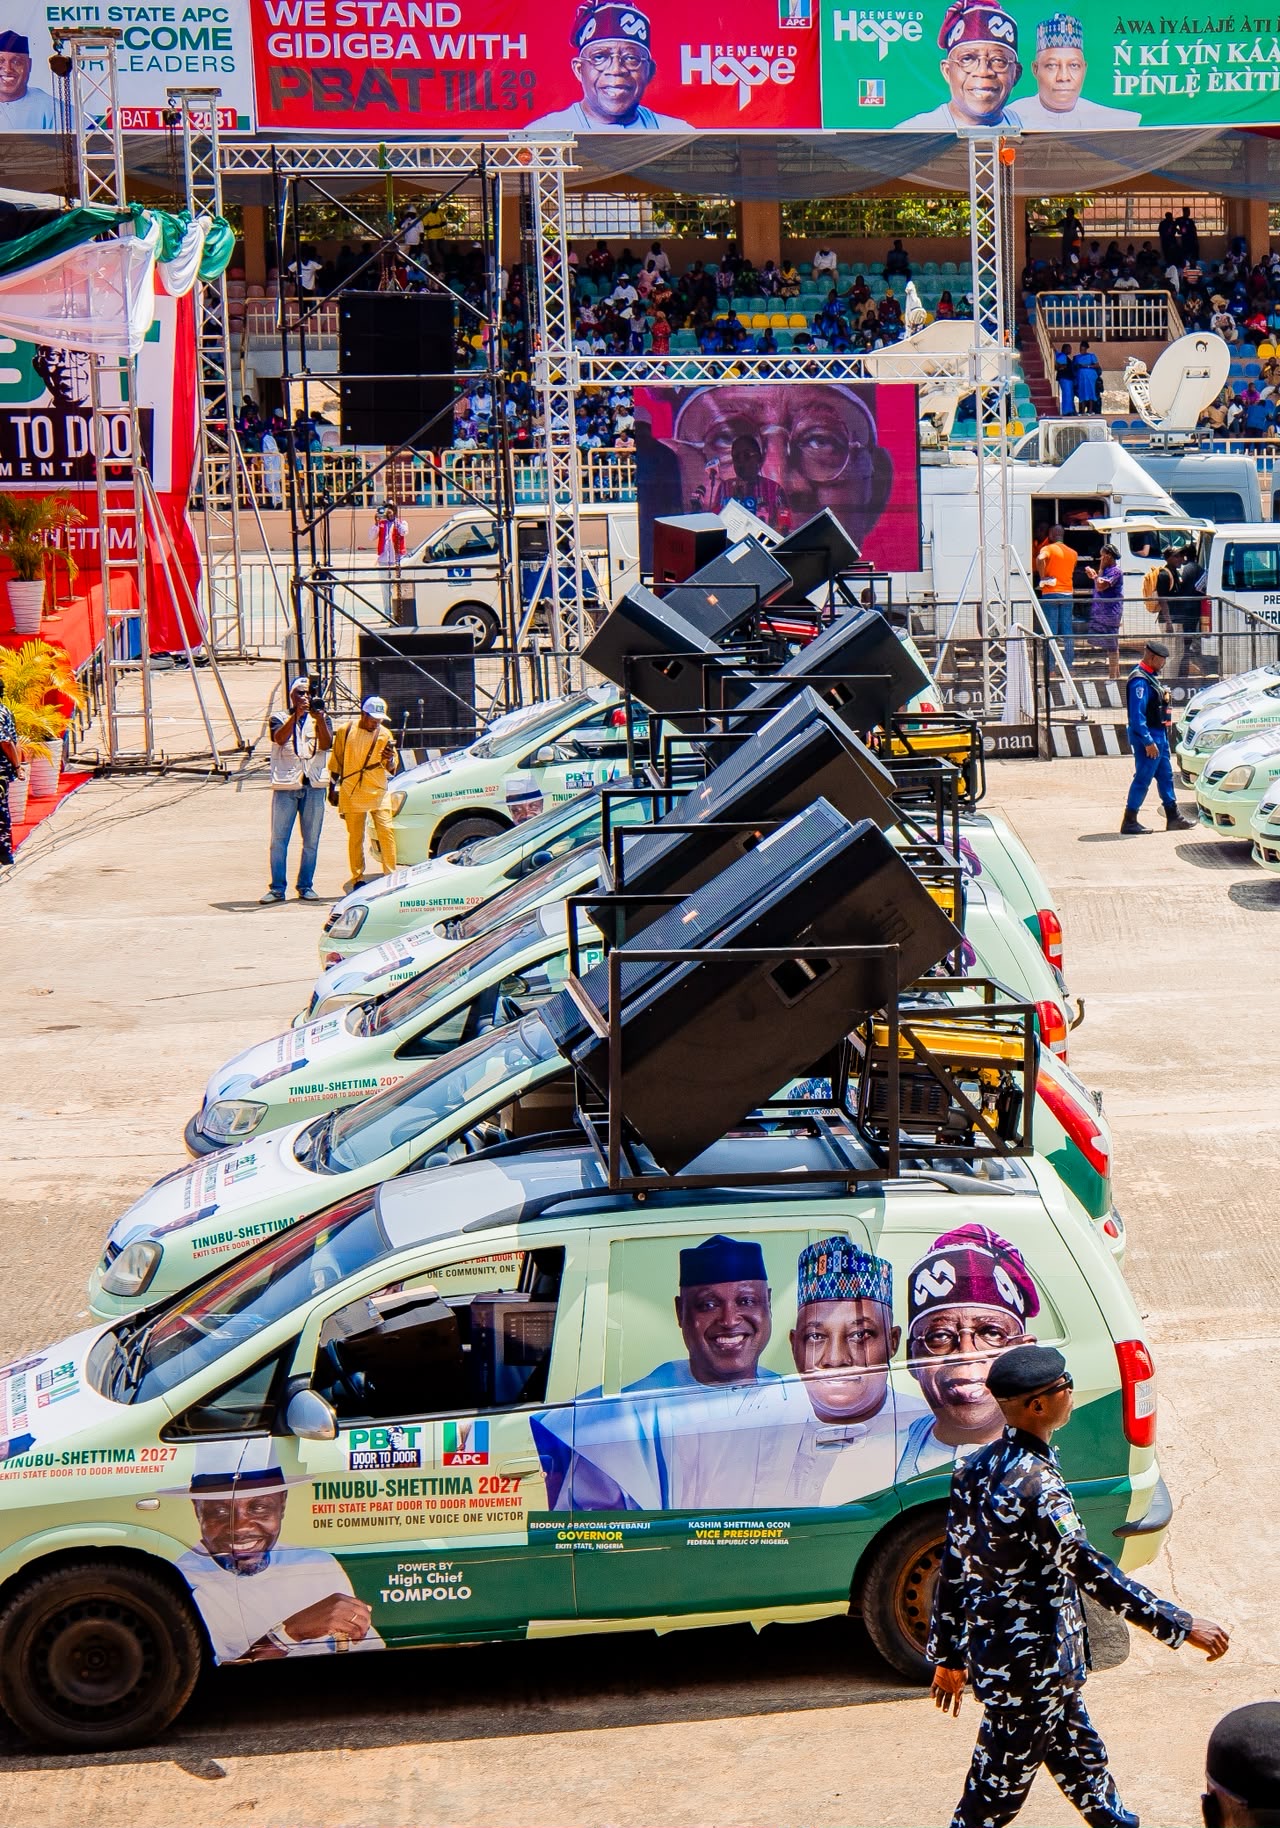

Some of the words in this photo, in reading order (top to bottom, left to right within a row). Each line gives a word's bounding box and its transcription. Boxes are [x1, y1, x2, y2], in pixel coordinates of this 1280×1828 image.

[46, 6, 100, 22] EKITI
[108, 7, 175, 22] STATE
[182, 7, 229, 23] APC
[265, 1, 326, 27] WE
[336, 1, 461, 28] STAND
[786, 18, 806, 26] APC
[860, 11, 924, 21] RENEWED
[833, 10, 924, 62] Hope
[267, 33, 421, 60] GIDIGBA
[430, 33, 527, 60] WITH
[715, 45, 798, 57] RENEWED
[1139, 39, 1170, 66] KÍ
[1174, 38, 1222, 65] YÍN
[501, 70, 537, 89] 20
[681, 45, 796, 111] Hope
[268, 66, 435, 113] PBAT
[440, 70, 499, 113] TILL
[502, 91, 535, 111] 31
[10, 414, 55, 459] TO
[432, 787, 484, 799] TINUBU-SHETTIMA
[485, 785, 500, 793] 2027
[400, 897, 465, 908] TINUBU-SHETTIMA
[466, 897, 484, 905] 2027
[289, 1078, 378, 1095] TINUBU-SHETTIMA
[193, 1250, 210, 1259] EKITI
[211, 1245, 230, 1255] STATE
[232, 1240, 251, 1250] DOOR
[427, 1270, 443, 1279] ONE
[446, 1266, 497, 1277] COMMUNITY,
[499, 1265, 516, 1273] ONE
[3, 1449, 136, 1469] TINUBU-SHETTIMA
[140, 1448, 178, 1462] 2027
[352, 1452, 377, 1465] DOOR
[378, 1451, 391, 1464] TO
[392, 1450, 417, 1463] DOOR
[451, 1454, 481, 1465] APC
[0, 1472, 20, 1481] EKITI
[22, 1470, 48, 1479] STATE
[50, 1468, 73, 1477] DOOR
[76, 1467, 87, 1476] TO
[90, 1466, 113, 1475] DOOR
[115, 1464, 165, 1474] MOVEMENT
[312, 1477, 473, 1500] TINUBU-SHETTIMA
[478, 1476, 521, 1495] 2027
[312, 1503, 336, 1514] EKITI
[338, 1503, 366, 1513] STATE
[369, 1502, 393, 1512] PBAT
[396, 1501, 423, 1511] DOOR
[426, 1500, 437, 1510] TO
[440, 1499, 466, 1510] DOOR
[469, 1497, 522, 1508] MOVEMENT
[312, 1519, 333, 1529] ONE
[336, 1516, 402, 1528] COMMUNITY,
[405, 1515, 426, 1525] ONE
[428, 1514, 460, 1524] VOICE
[463, 1513, 485, 1523] ONE
[487, 1511, 524, 1522] VICTOR
[557, 1531, 623, 1541] GOVERNOR
[695, 1530, 721, 1538] VICE
[723, 1529, 783, 1538] PRESIDENT
[397, 1563, 436, 1572] POWER
[439, 1562, 453, 1571] BY
[388, 1574, 423, 1587] High
[427, 1571, 463, 1584] Chief
[380, 1586, 472, 1603] TOMPOLO
